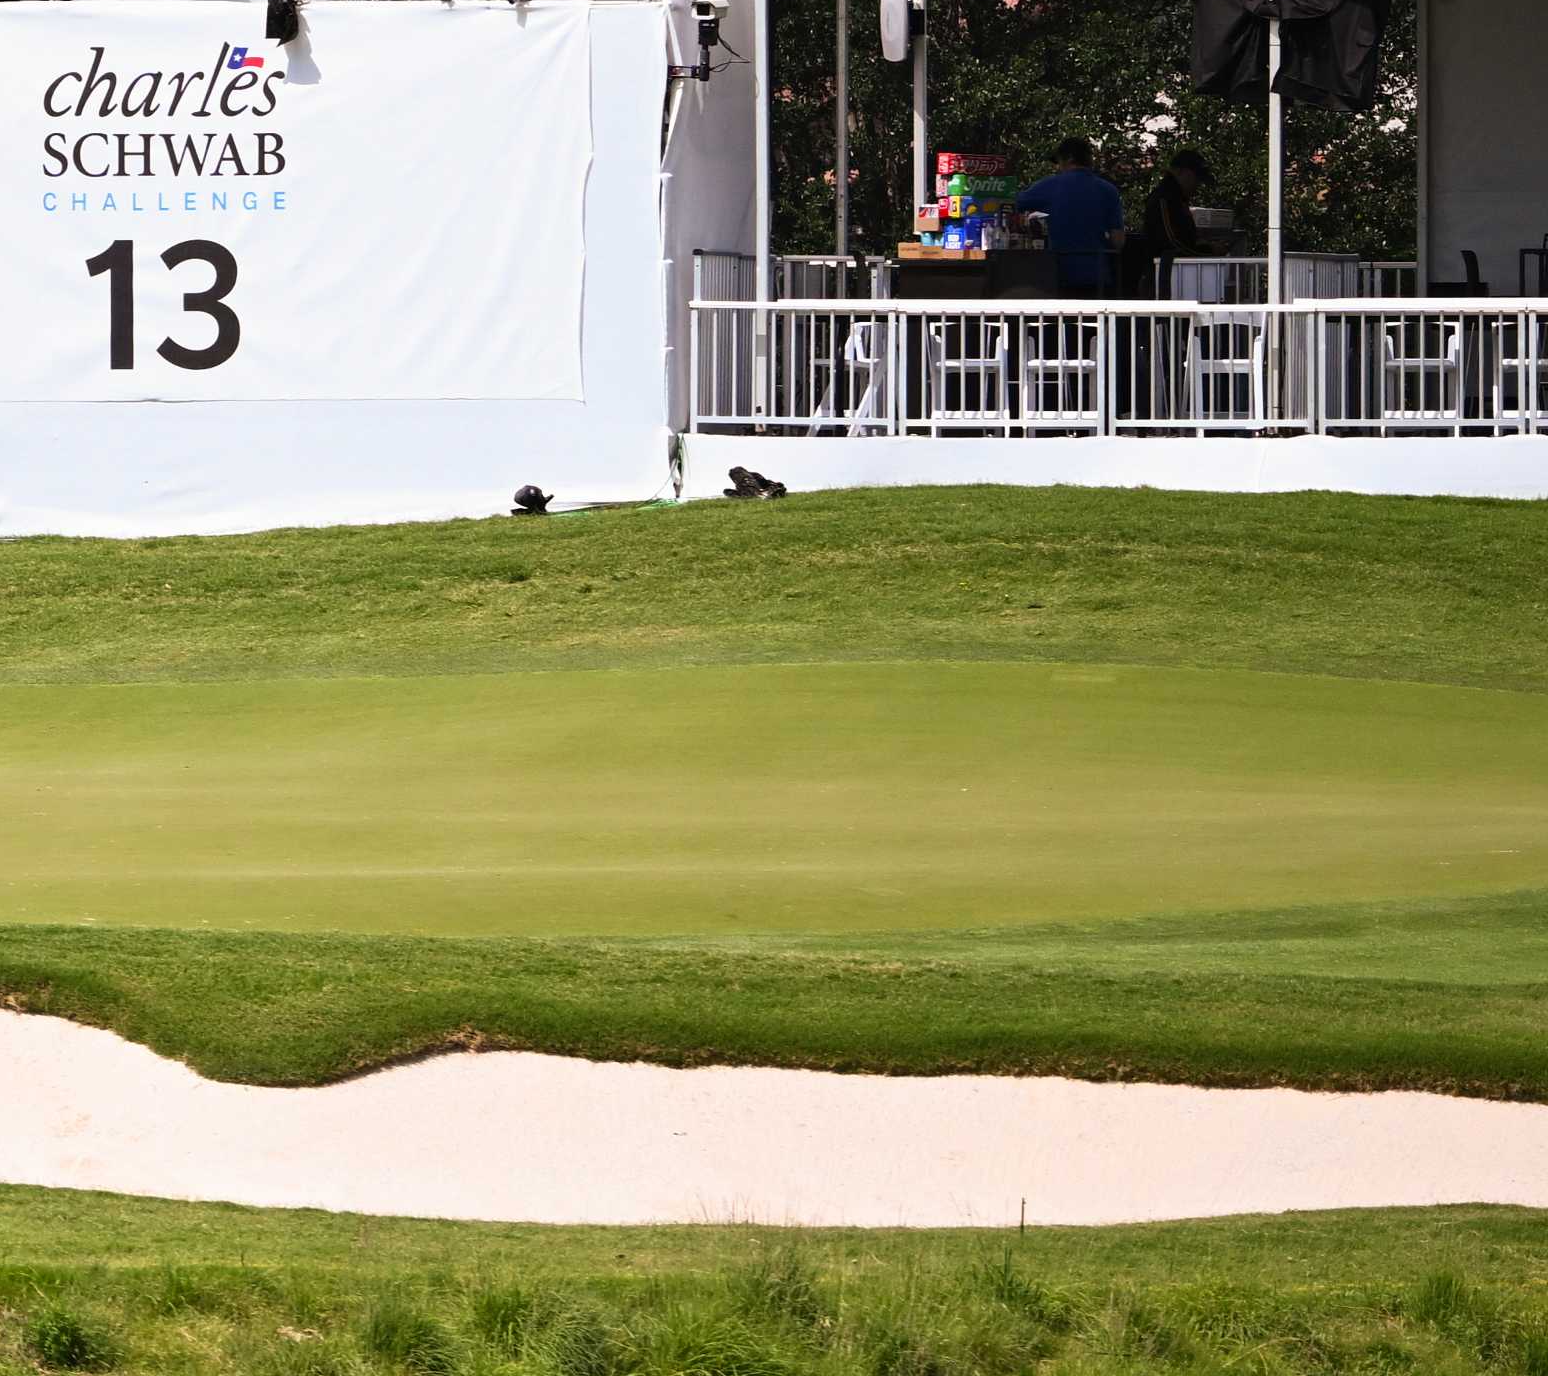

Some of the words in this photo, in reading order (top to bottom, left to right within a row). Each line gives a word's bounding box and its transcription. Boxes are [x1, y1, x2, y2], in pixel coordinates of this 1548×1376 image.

[43, 41, 285, 117] charles
[42, 132, 286, 177] SCHWAB
[42, 191, 286, 211] CHALLENGE
[86, 239, 241, 370] 13
